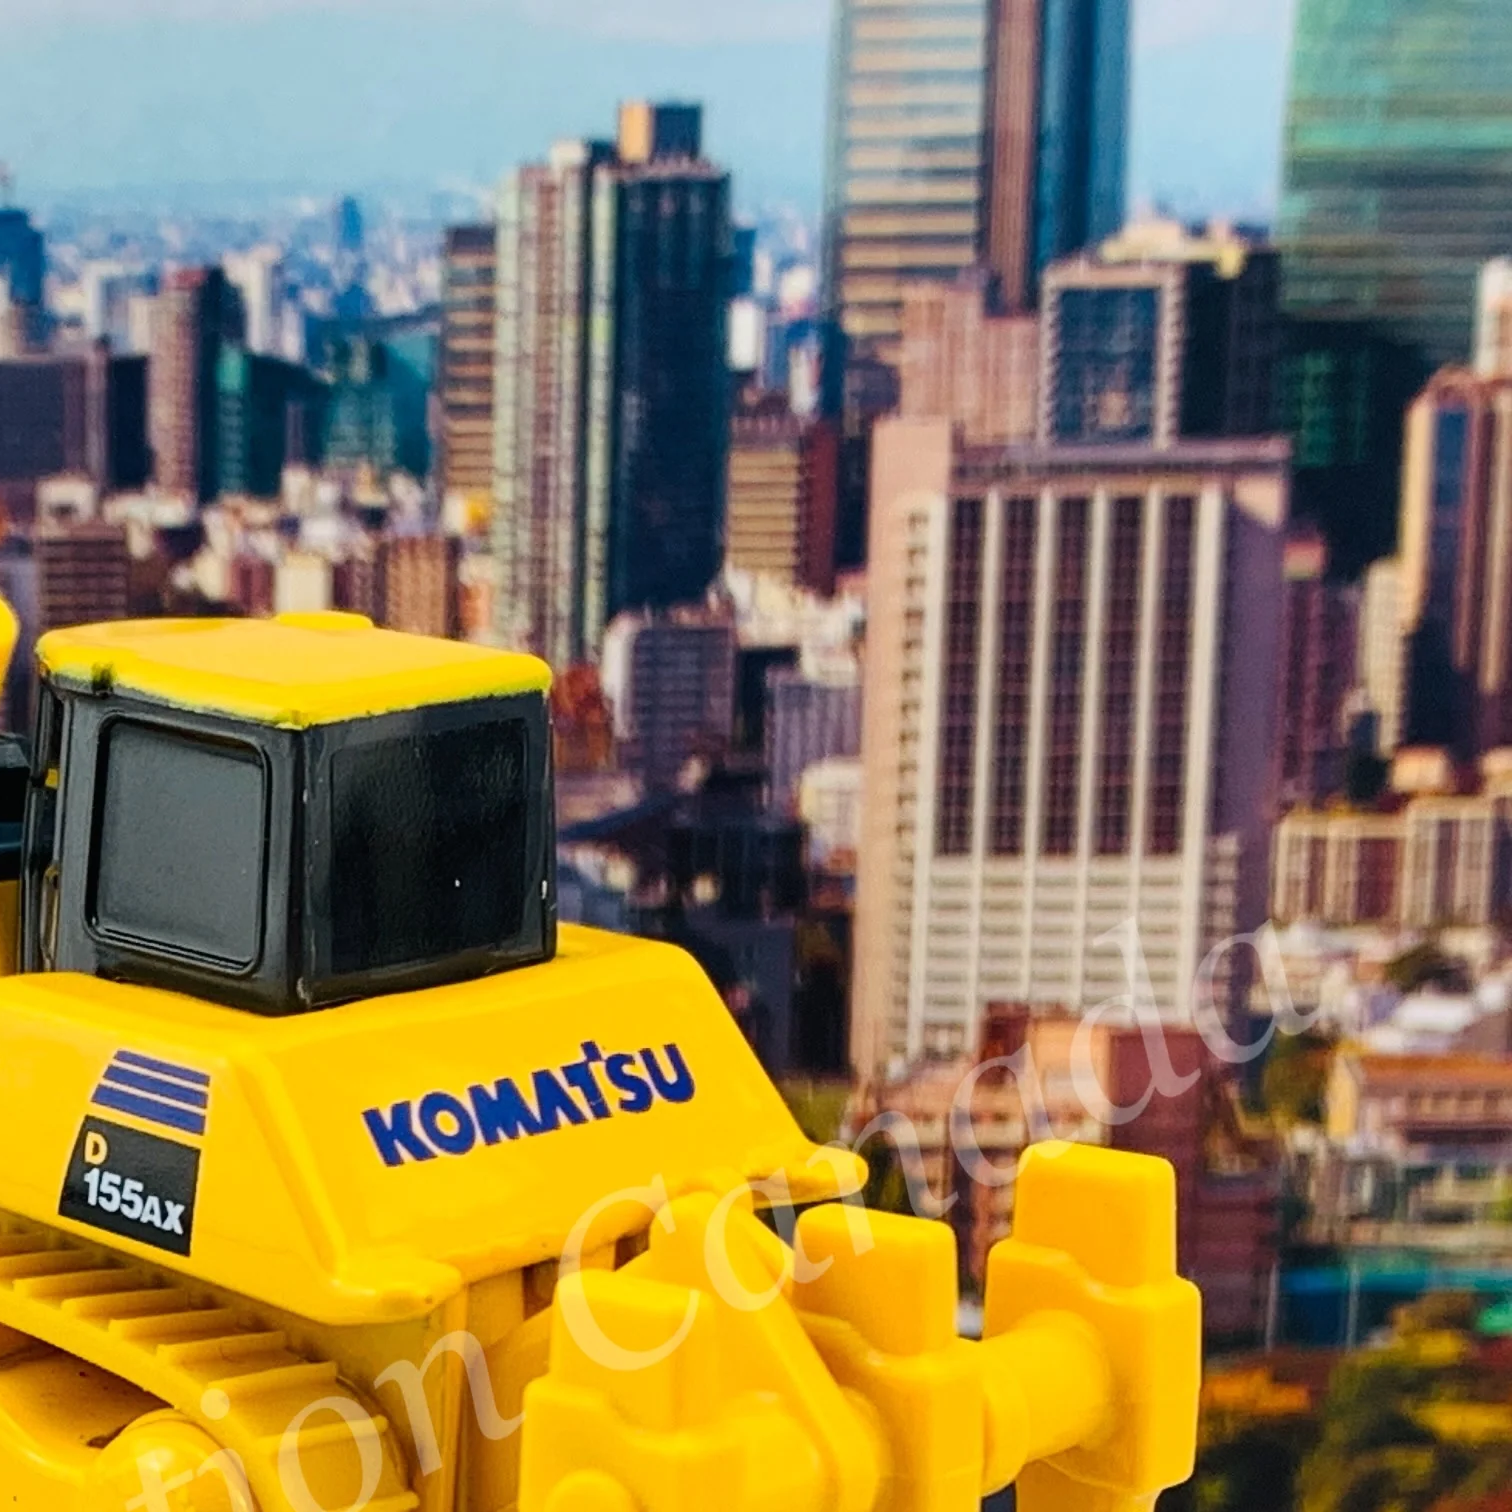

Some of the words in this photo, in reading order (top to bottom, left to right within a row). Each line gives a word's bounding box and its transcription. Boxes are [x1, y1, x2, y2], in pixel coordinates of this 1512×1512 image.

[361, 1040, 695, 1167] KOMATSU
[85, 1131, 108, 1165] D
[84, 1167, 185, 1236] 155AX
